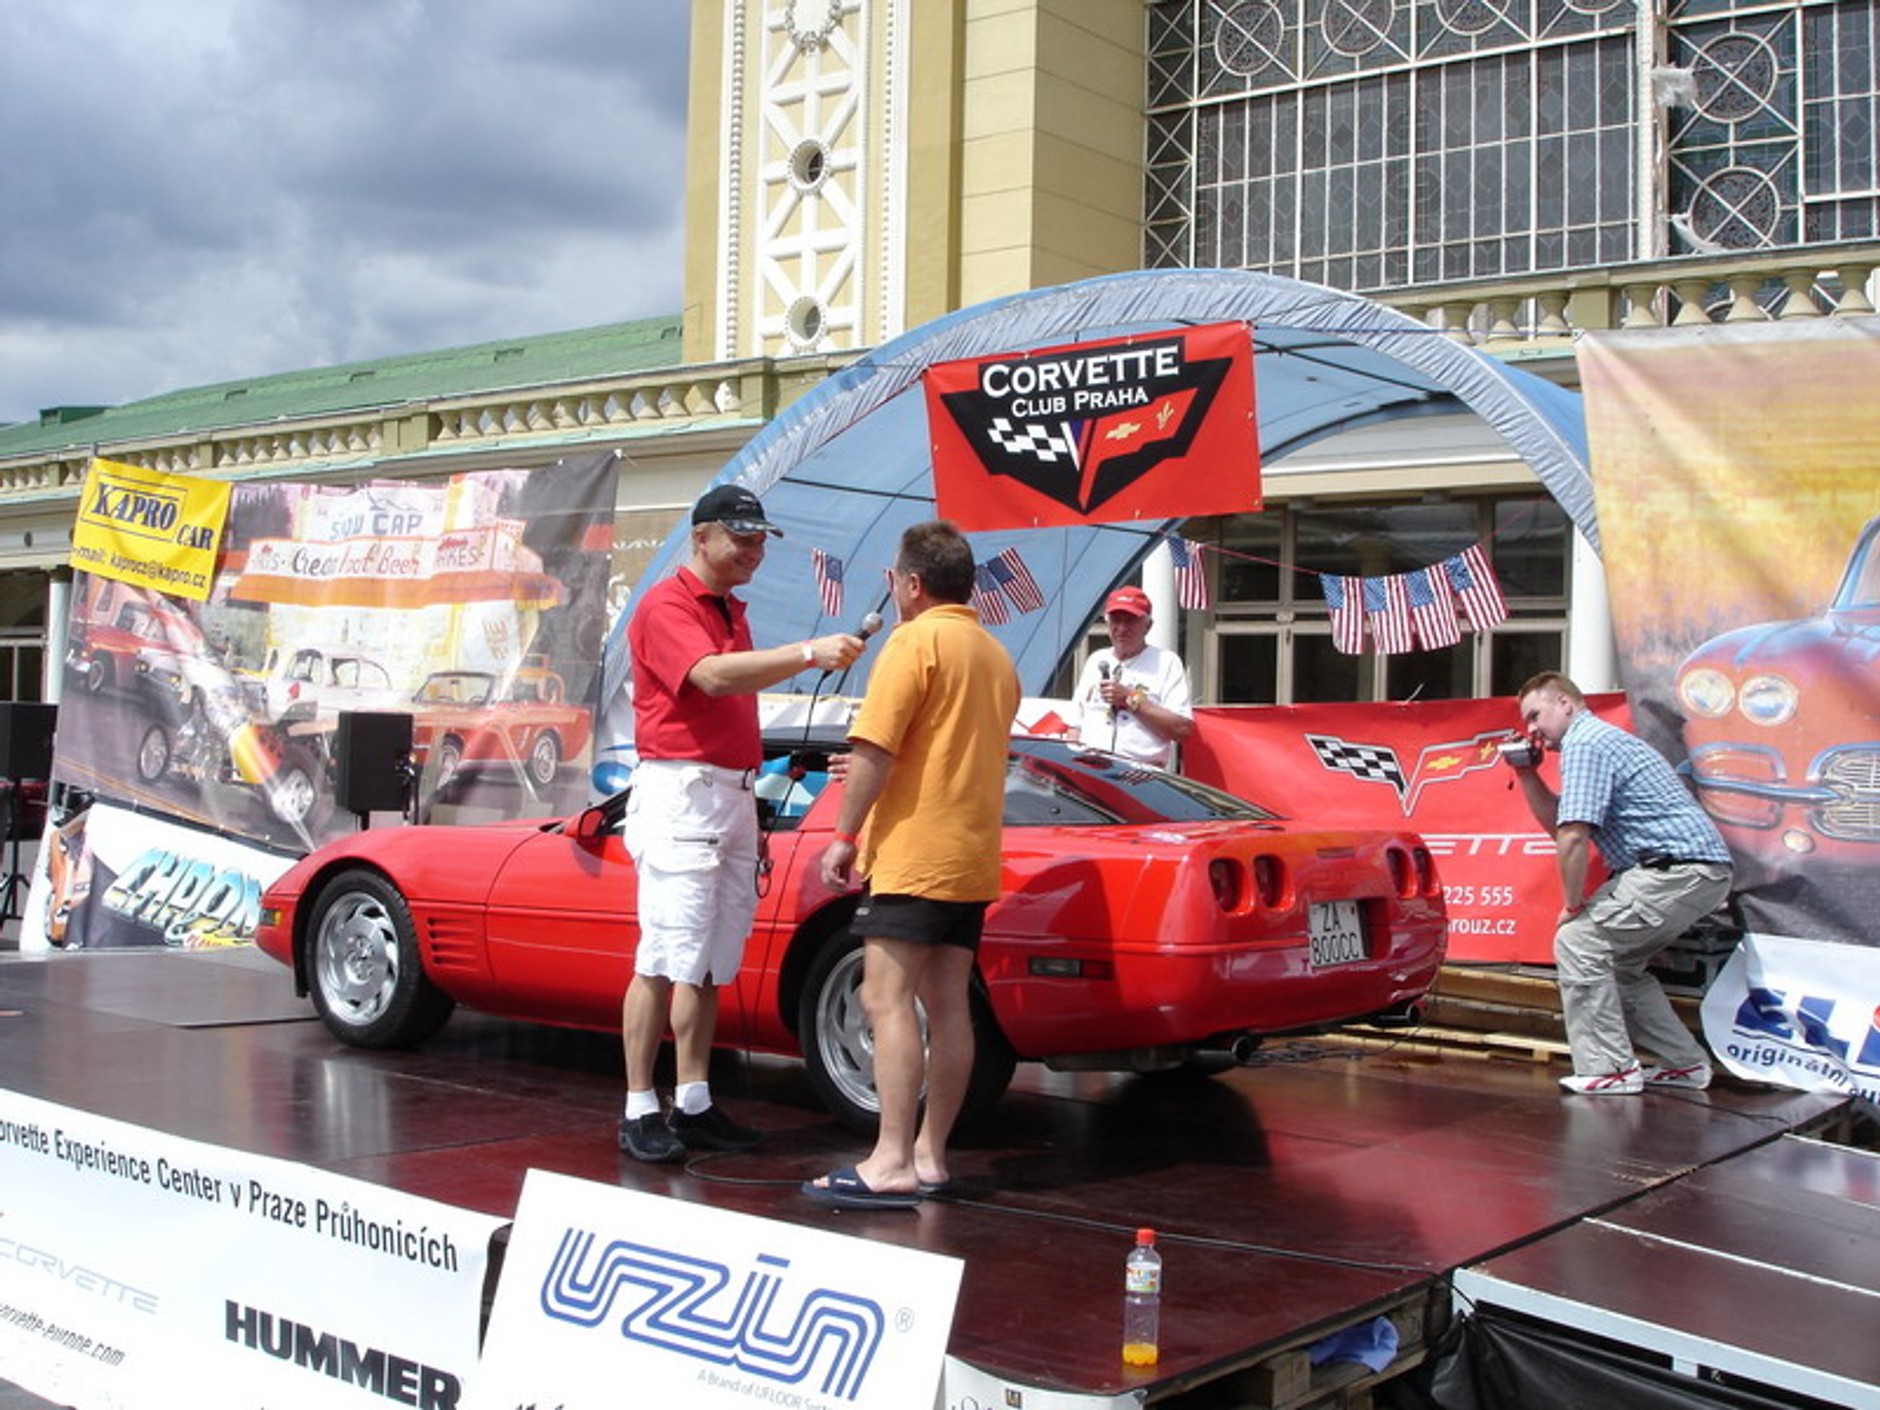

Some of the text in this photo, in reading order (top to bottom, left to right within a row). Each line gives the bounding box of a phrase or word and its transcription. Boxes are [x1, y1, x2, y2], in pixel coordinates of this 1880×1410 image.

[982, 345, 1179, 397] CORVETTE
[1011, 387, 1149, 418] CLUB PRAHA
[92, 482, 214, 551] KAPRO CAR
[372, 513, 424, 535] CAP
[1479, 885, 1514, 906] 555
[1319, 902, 1342, 932] ZA
[54, 1129, 151, 1184] Experience
[157, 1157, 222, 1203] Center
[230, 1182, 242, 1208] v
[249, 1179, 307, 1228] Praze
[316, 1199, 458, 1272] Průhonicích
[225, 1299, 462, 1410] HUMMER
